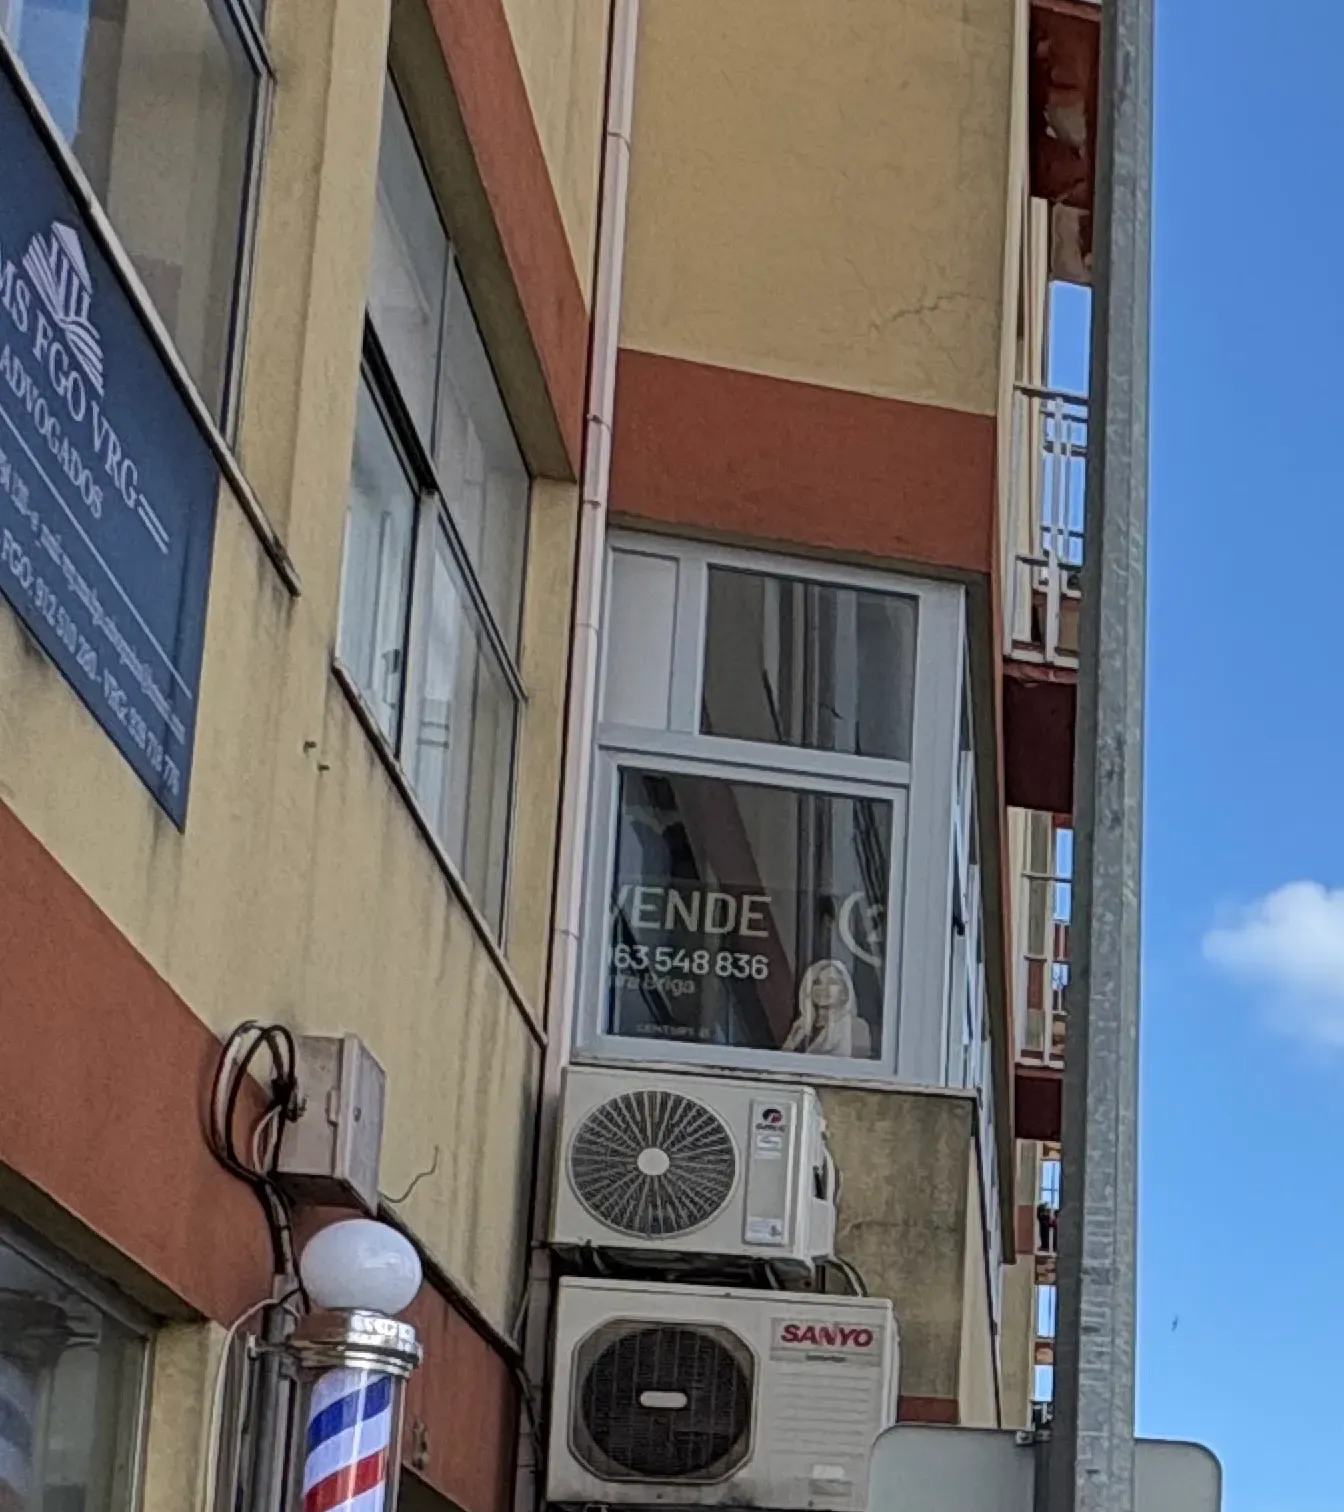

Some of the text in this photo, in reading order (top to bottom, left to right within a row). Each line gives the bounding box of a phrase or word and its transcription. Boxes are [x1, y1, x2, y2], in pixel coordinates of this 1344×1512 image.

[0, 343, 103, 520] ADVOGADOS
[32, 309, 86, 421] FGO
[91, 400, 139, 510] VRG
[655, 946, 710, 976] 548
[715, 951, 769, 980] 836
[781, 1324, 874, 1348] SANYO
